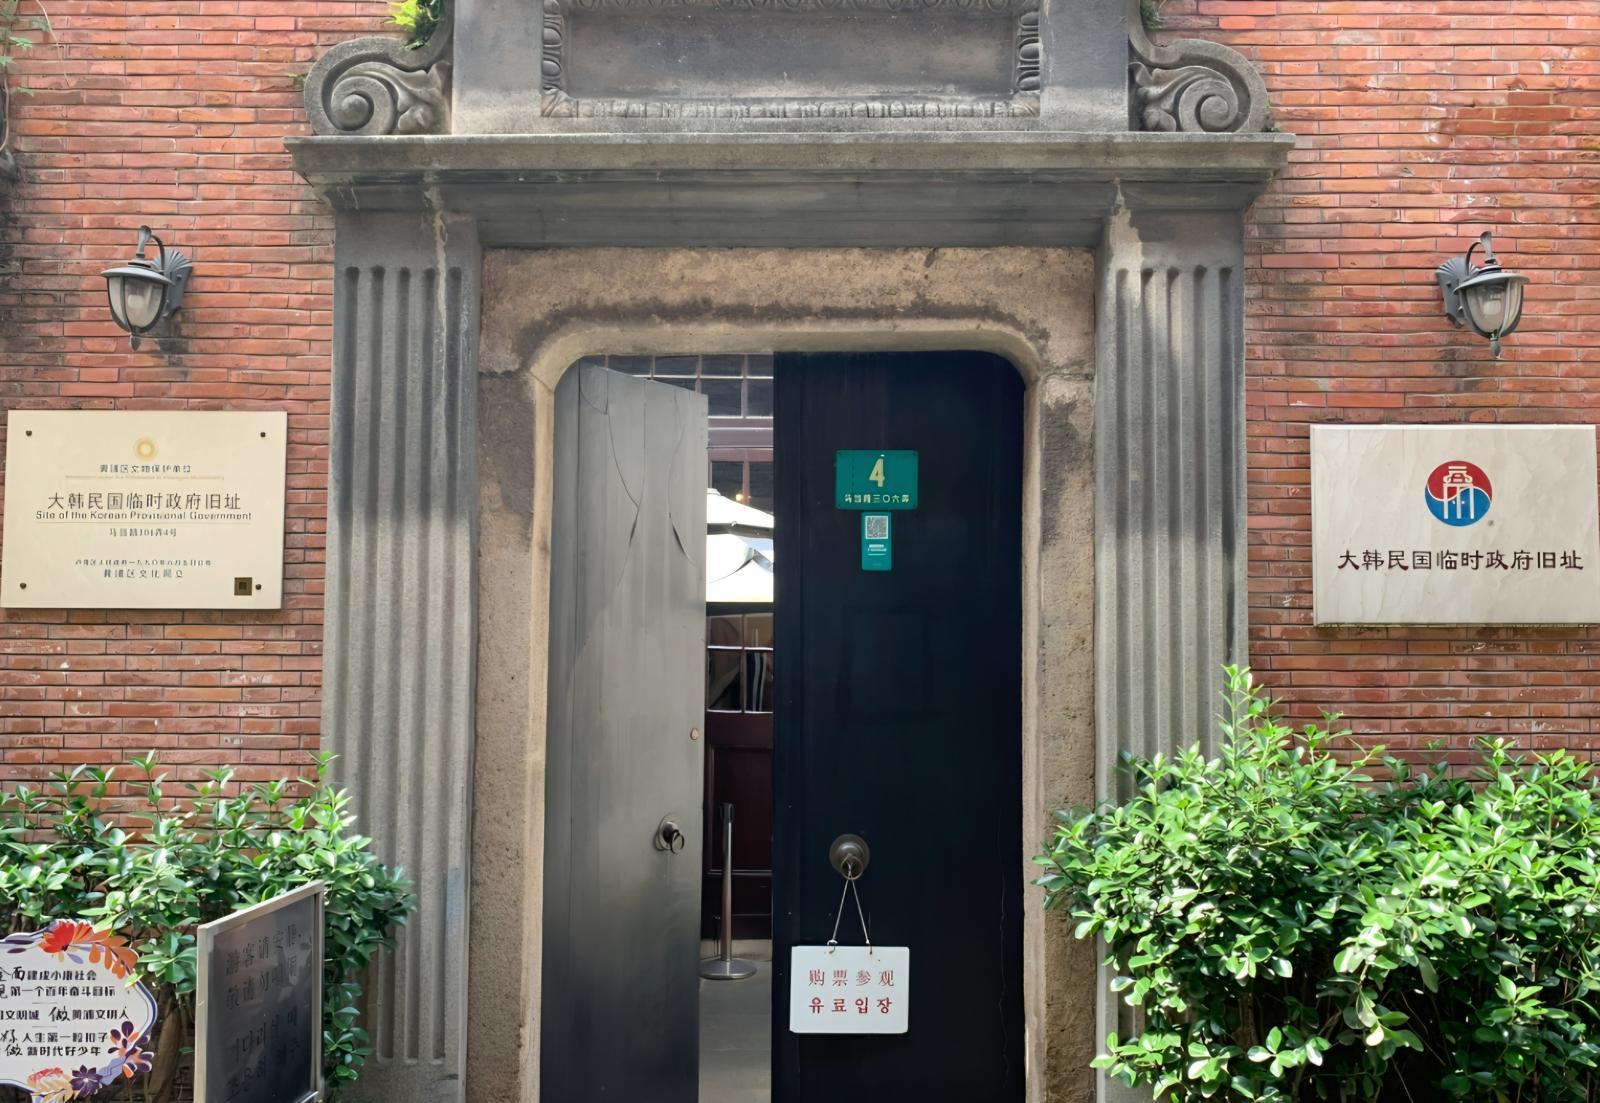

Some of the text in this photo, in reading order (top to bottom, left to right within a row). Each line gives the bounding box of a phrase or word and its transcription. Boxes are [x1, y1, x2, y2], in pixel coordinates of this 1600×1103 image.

[869, 457, 886, 488] 4
[47, 492, 241, 510] 大韩民国临时政府旧址
[36, 510, 252, 520] Site of the Korean Provisional Government
[1337, 549, 1584, 571] 大韩民国临时政府旧址
[808, 969, 895, 987] 购票参观
[808, 996, 893, 1014] 유료입장
[0, 1009, 40, 1021] 文明城
